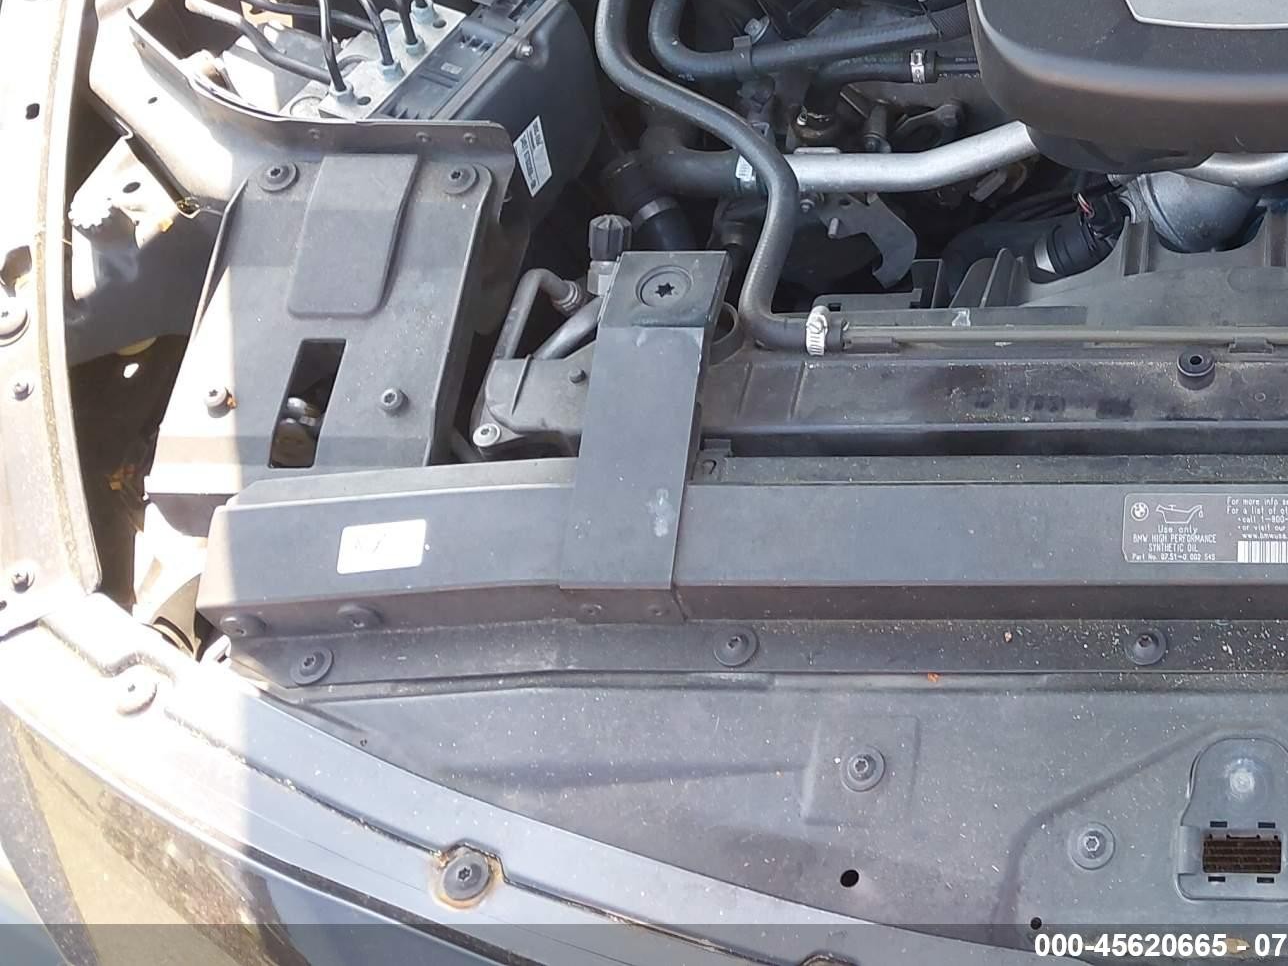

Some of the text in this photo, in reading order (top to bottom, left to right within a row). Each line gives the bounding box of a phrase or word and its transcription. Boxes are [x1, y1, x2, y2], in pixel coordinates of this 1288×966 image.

[1226, 496, 1239, 506] For
[1242, 498, 1259, 506] more
[1264, 496, 1278, 506] info
[1226, 505, 1239, 515] For
[1243, 507, 1248, 515] a
[1251, 505, 1264, 516] list
[1268, 505, 1276, 515] of
[1242, 515, 1256, 523] call
[1157, 524, 1198, 536] Use only
[1253, 524, 1270, 532] visit
[1132, 534, 1217, 544] BMW HIGH PERFORMANCE
[1148, 543, 1198, 553] SYNTHETIC OIL
